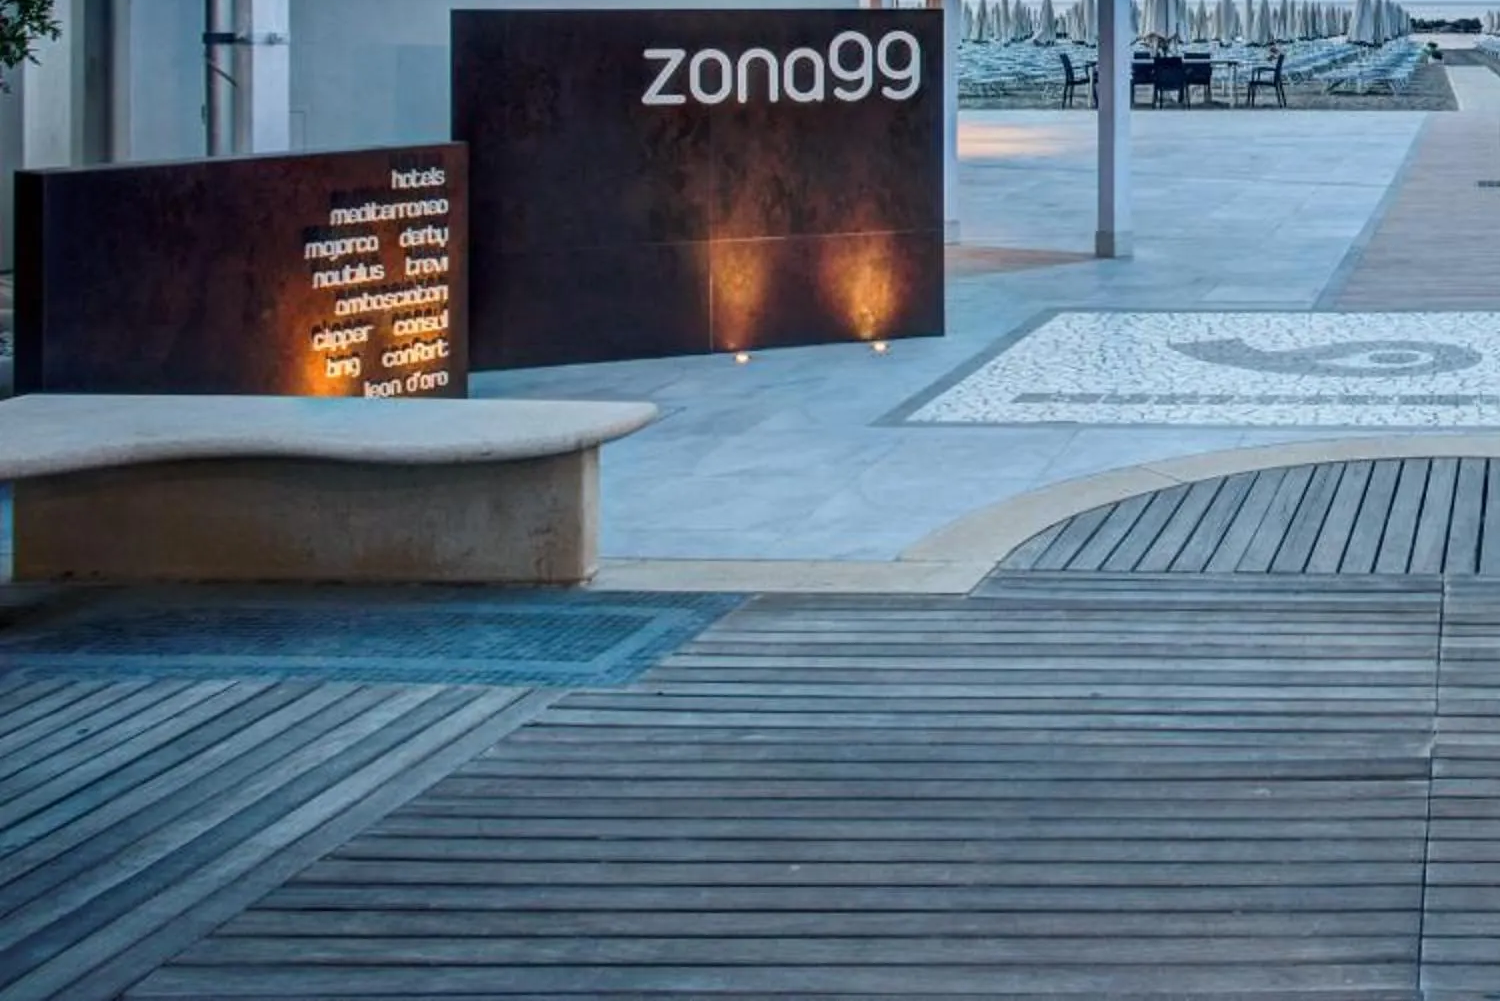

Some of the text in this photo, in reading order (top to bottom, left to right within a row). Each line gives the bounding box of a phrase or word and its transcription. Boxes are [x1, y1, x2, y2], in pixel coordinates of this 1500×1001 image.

[641, 31, 922, 104] zona99
[391, 166, 446, 190] hotels
[330, 198, 449, 227] mediterraneo
[304, 235, 379, 261] majorca
[399, 224, 449, 248] derby
[312, 263, 386, 289] nautilus
[405, 256, 449, 276] brevi
[335, 284, 449, 316] ambasciatori
[393, 309, 449, 336] consul
[313, 326, 374, 352] clipper
[381, 339, 449, 368] confort
